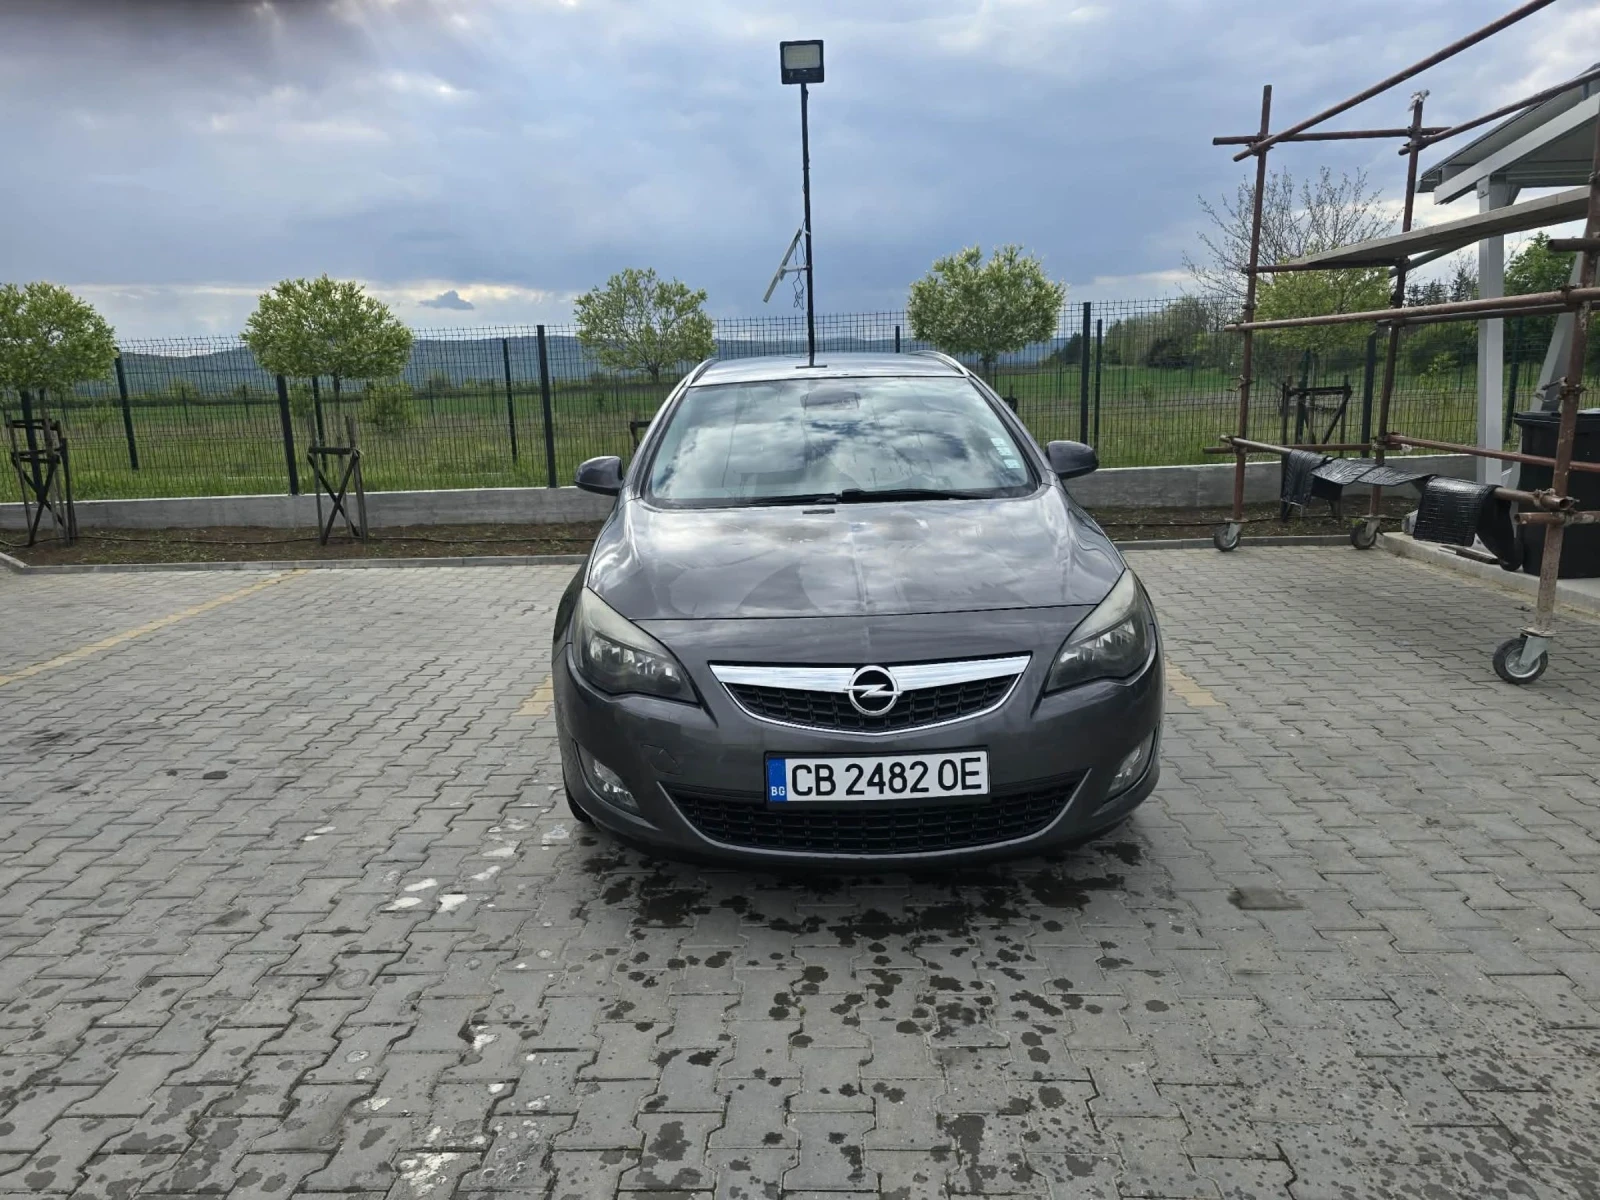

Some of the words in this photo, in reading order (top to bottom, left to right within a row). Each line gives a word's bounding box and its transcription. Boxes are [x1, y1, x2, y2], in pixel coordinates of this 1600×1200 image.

[792, 764, 836, 796] CB
[845, 761, 930, 796] 2482
[938, 757, 982, 791] OE
[771, 786, 785, 796] BG
